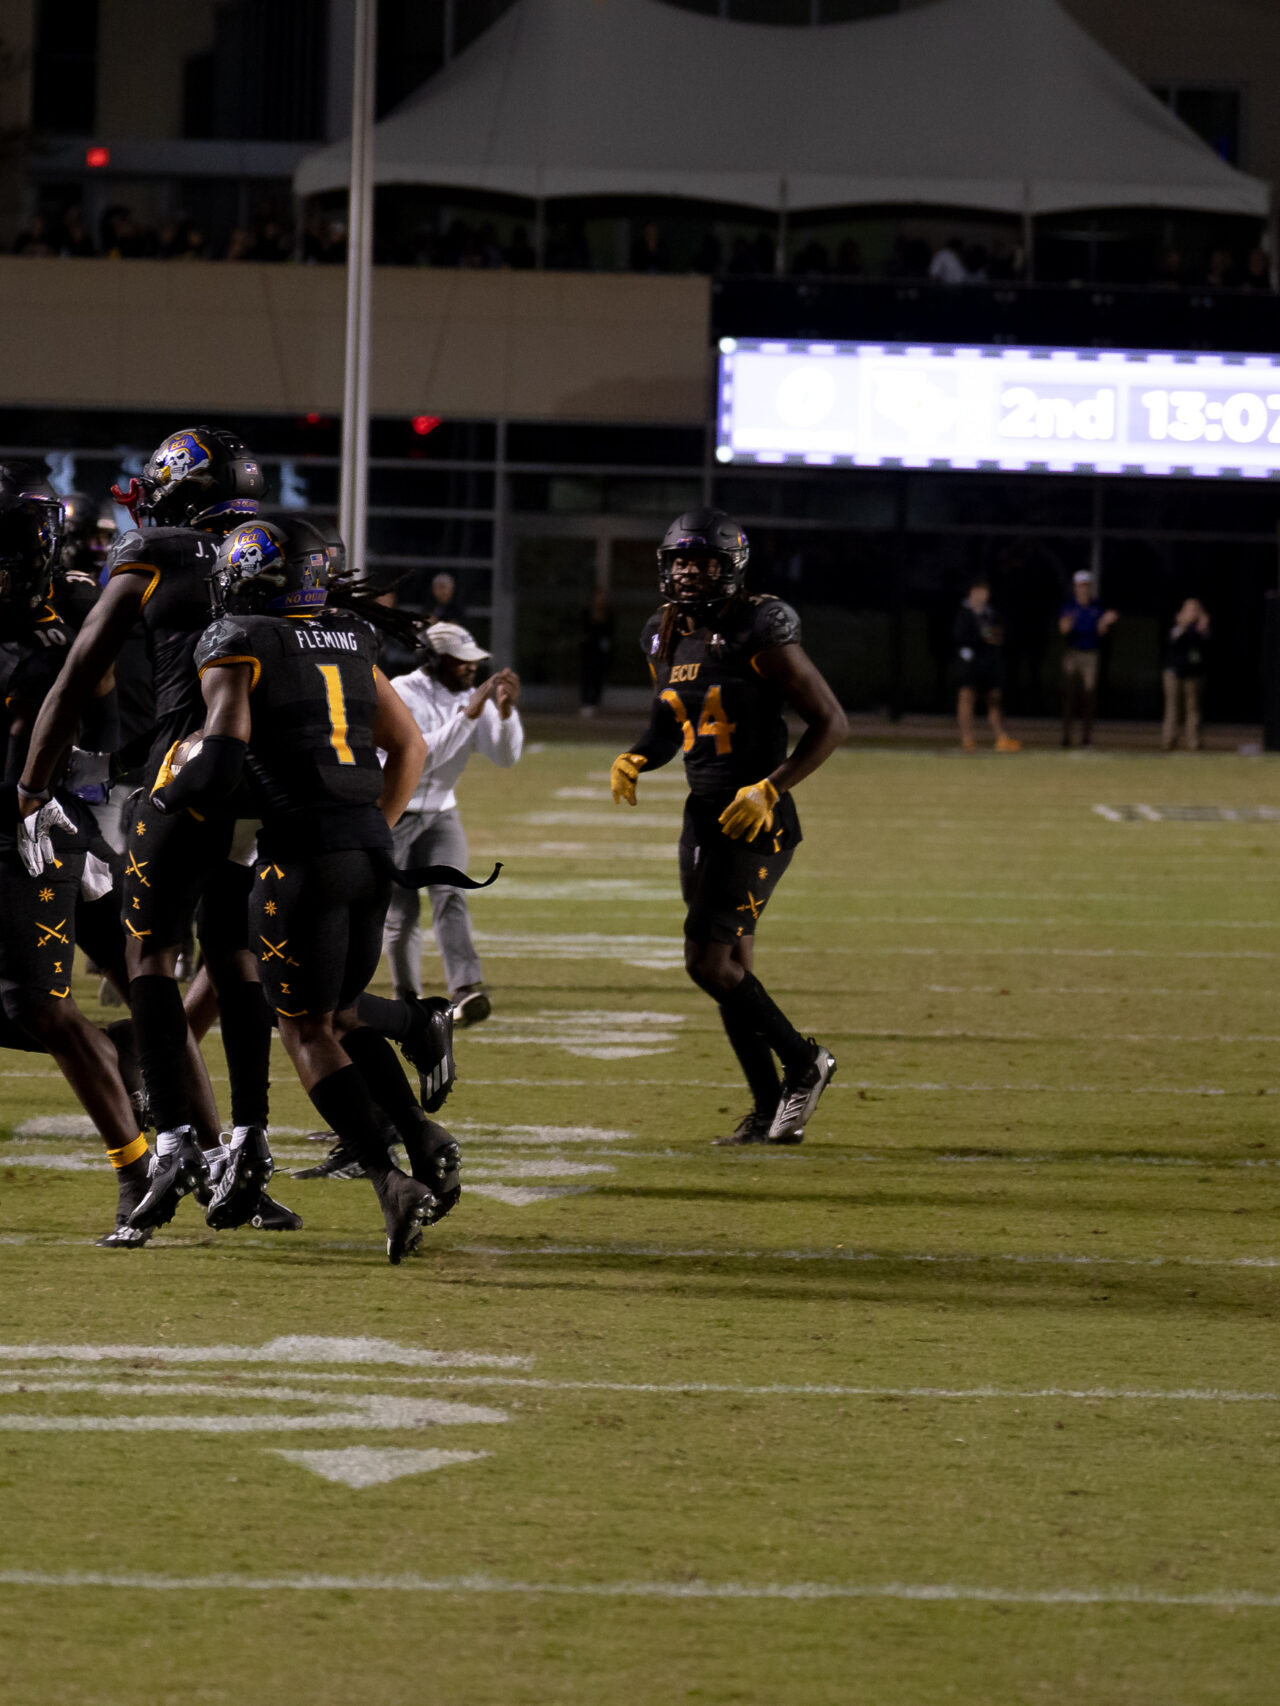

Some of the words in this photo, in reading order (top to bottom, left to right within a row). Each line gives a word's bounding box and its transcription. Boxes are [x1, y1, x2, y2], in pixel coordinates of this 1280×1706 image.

[998, 387, 1116, 440] 2nd
[171, 440, 188, 450] ECU
[241, 532, 262, 544] ECU
[33, 628, 67, 648] 10
[294, 630, 358, 651] FLEMING
[668, 663, 702, 684] ECU
[314, 664, 357, 765] 1
